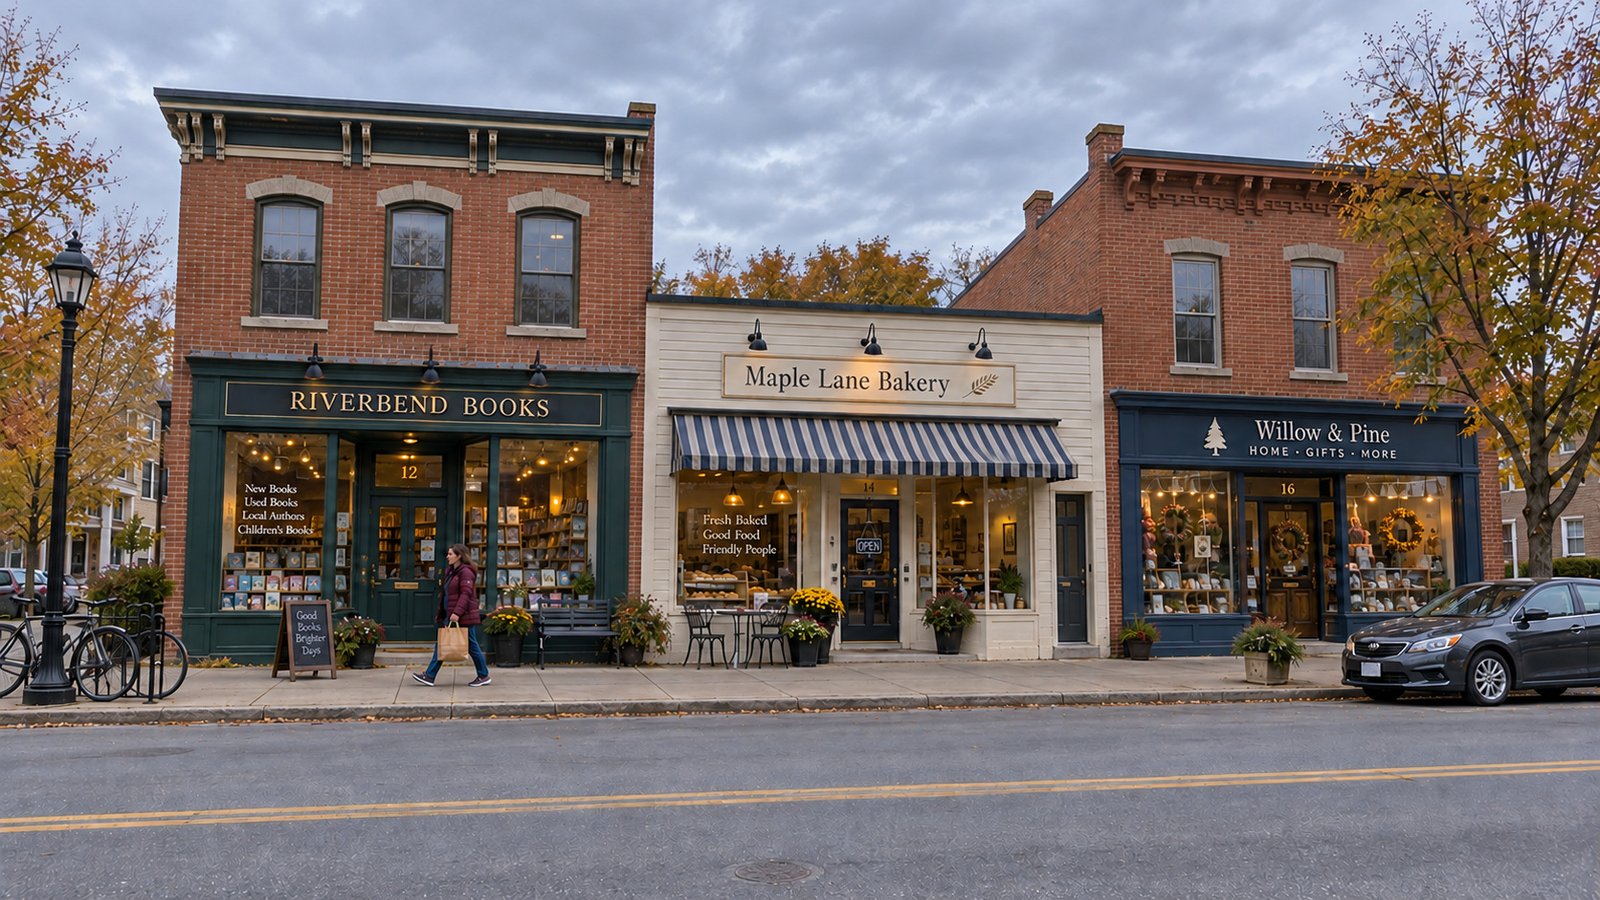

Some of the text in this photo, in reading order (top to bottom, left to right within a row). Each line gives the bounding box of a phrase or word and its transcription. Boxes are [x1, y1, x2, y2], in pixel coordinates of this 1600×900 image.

[745, 365, 950, 398] Maple Lane Bakery
[290, 391, 550, 418] RIVERBEND BOOKS
[1255, 419, 1390, 443] Willow & Pine
[1249, 446, 1397, 459] HOME GIFTS MORE
[401, 465, 418, 479] 12
[245, 483, 297, 494] New Books
[864, 482, 874, 492] 14
[1281, 483, 1295, 495] 16
[245, 497, 298, 507] Used Books
[242, 510, 305, 520] Local Authors
[703, 514, 768, 526] Fresh Baked
[286, 525, 314, 535] Books
[703, 528, 760, 540] Good Food
[702, 543, 777, 557] Friendly People
[858, 541, 880, 552] OPEN
[296, 610, 317, 620] Good
[297, 622, 321, 632] Books
[302, 646, 321, 658] Days
